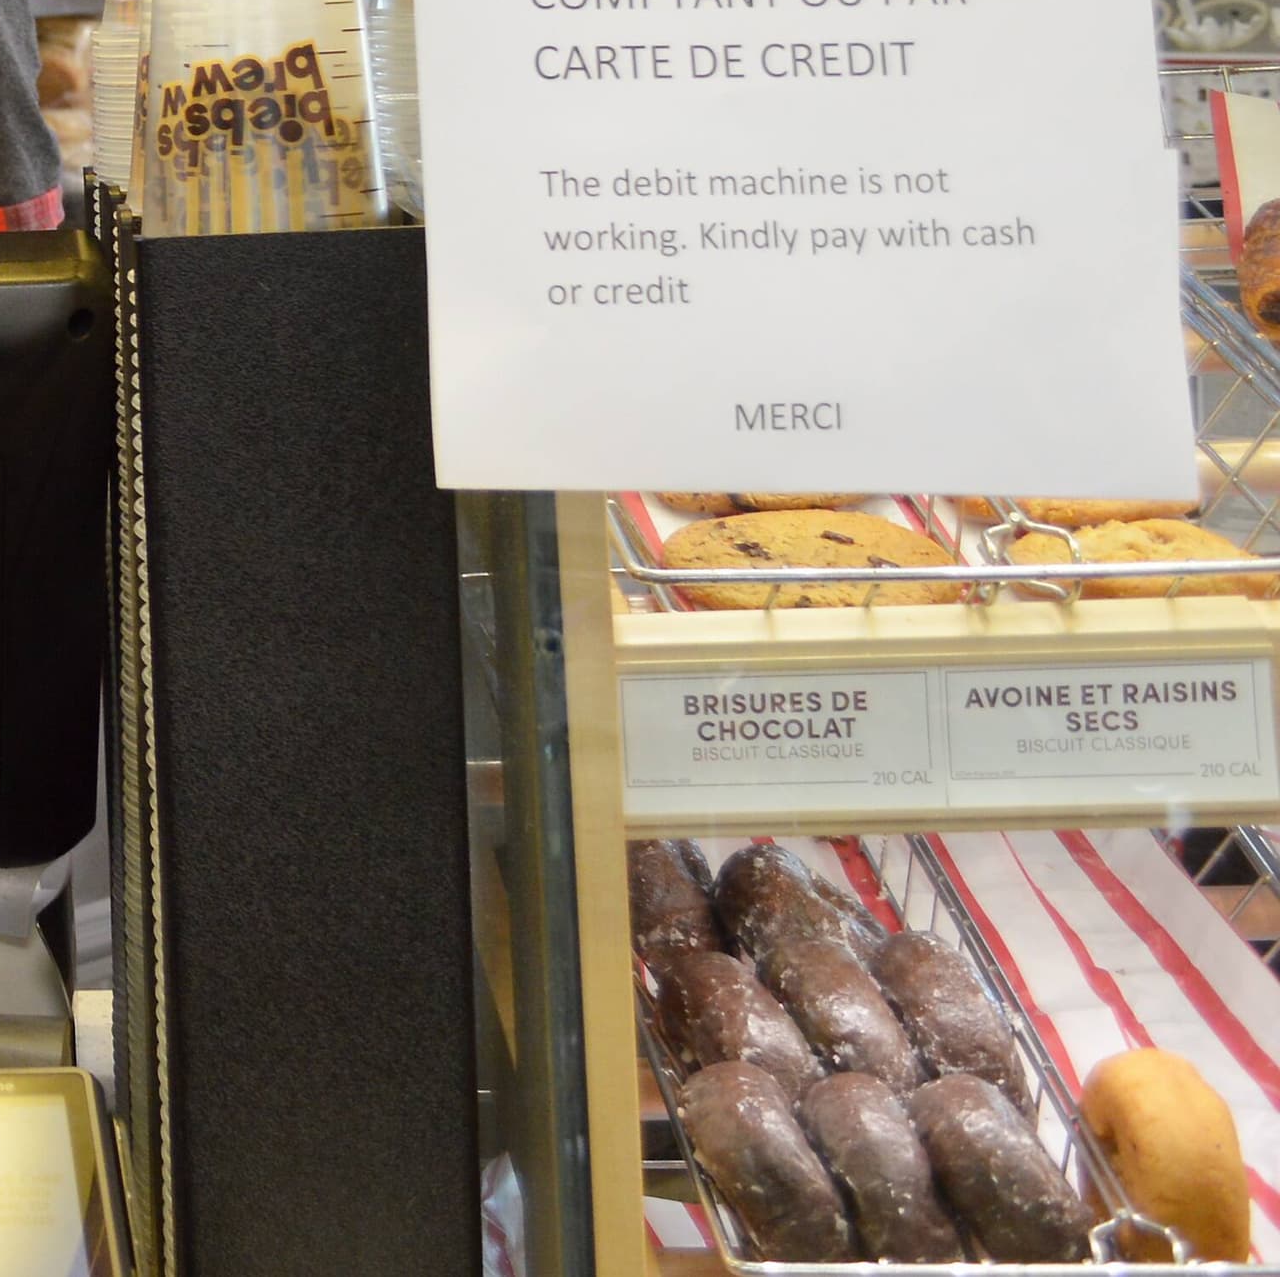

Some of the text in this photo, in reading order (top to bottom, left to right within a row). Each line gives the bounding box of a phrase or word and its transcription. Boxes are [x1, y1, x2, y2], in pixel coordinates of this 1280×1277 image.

[191, 43, 324, 98] brew
[534, 41, 916, 81] CARTE DE CREDIT
[540, 166, 951, 199] The debit machine is not
[544, 217, 1036, 257] working. Kindly pay with cash
[547, 275, 691, 307] or credit
[734, 402, 843, 431] MERCI
[683, 690, 868, 716] BRISURES DE
[965, 680, 1237, 708] AVOINE ET RAISINS
[697, 718, 856, 742] CHOCOLAT
[1066, 710, 1139, 732] SECS
[692, 743, 865, 762] BISCUIT CLASSIQUE
[1016, 734, 1192, 754] BISCUIT CLASSIQUE
[872, 770, 933, 786] 210 CAL
[1199, 762, 1261, 778] 210 CAL
